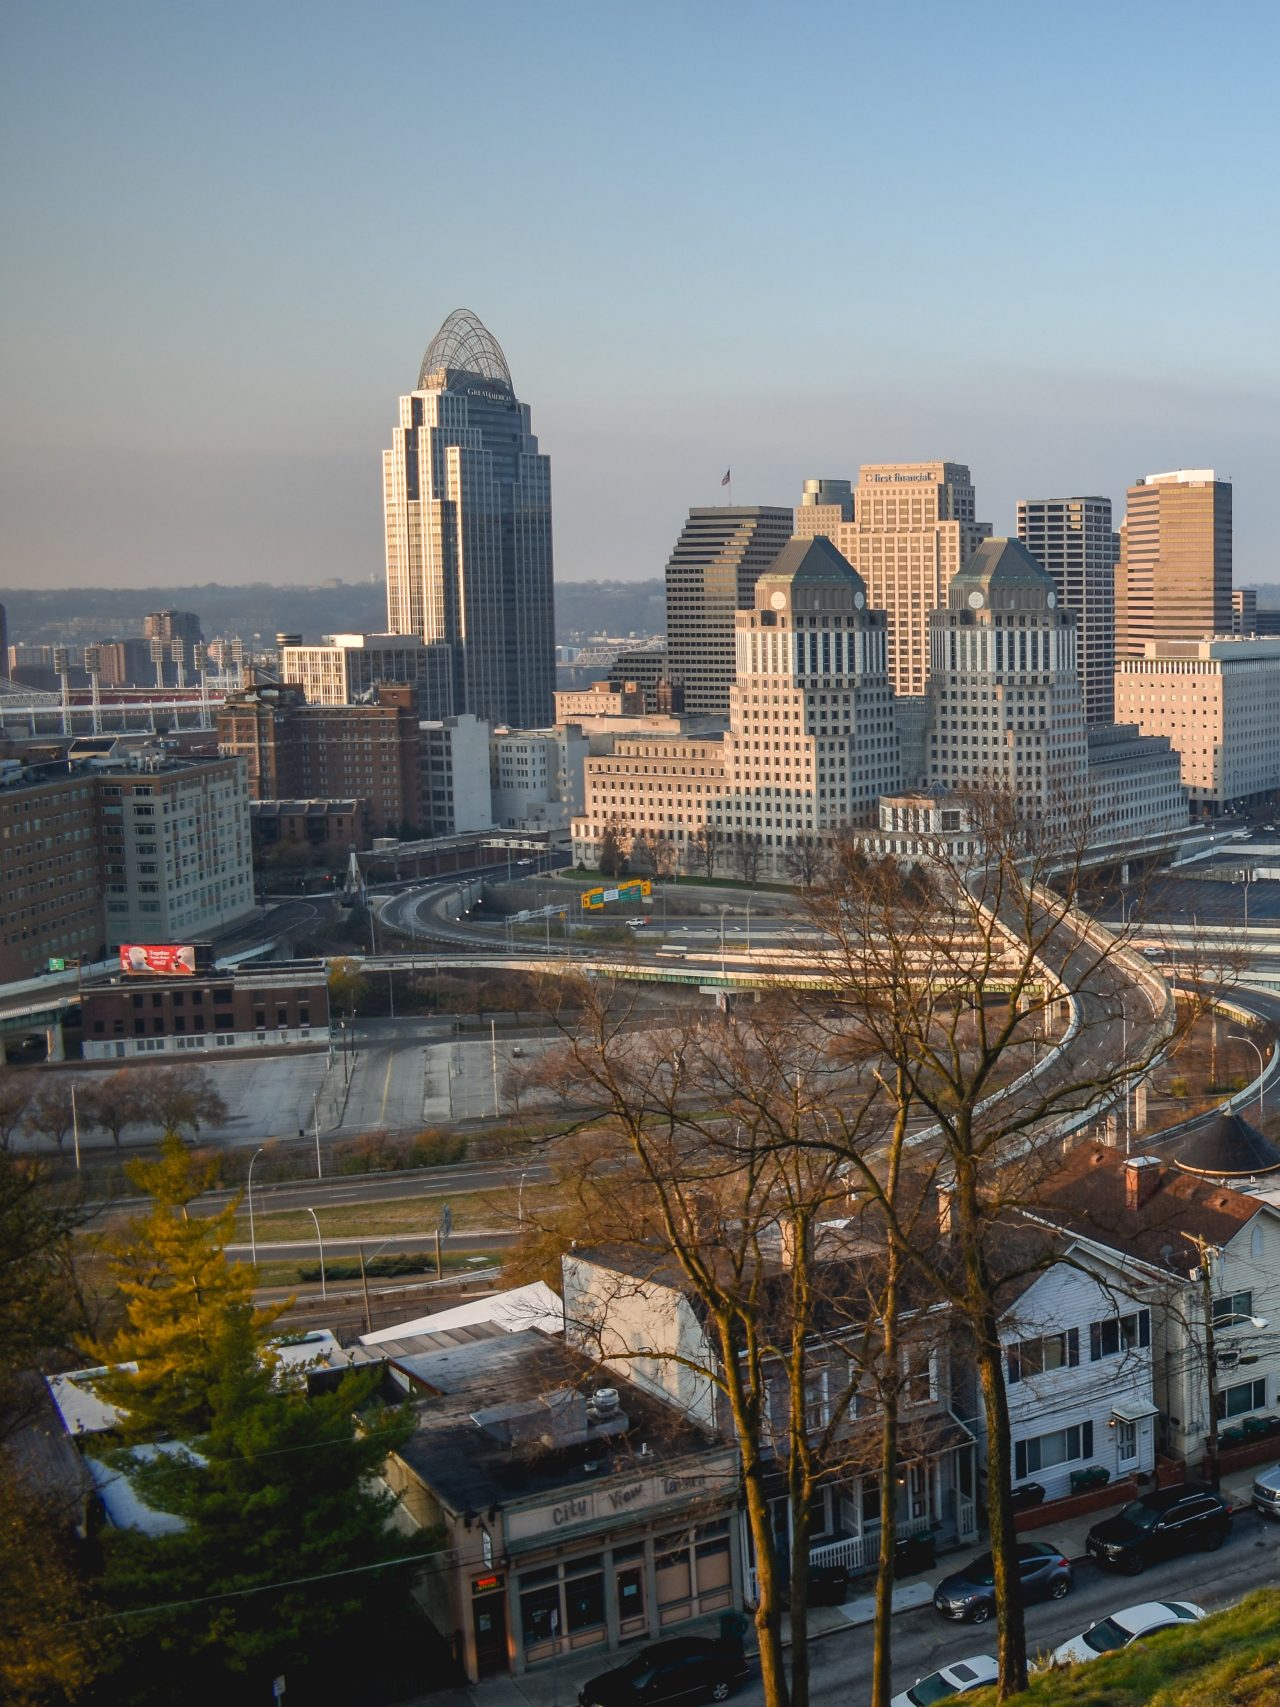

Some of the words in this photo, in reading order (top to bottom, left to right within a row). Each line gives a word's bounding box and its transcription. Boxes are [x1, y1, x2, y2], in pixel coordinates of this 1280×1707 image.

[875, 474, 892, 482] first
[895, 473, 931, 482] financial
[552, 1497, 587, 1526] City
[607, 1483, 644, 1509] View
